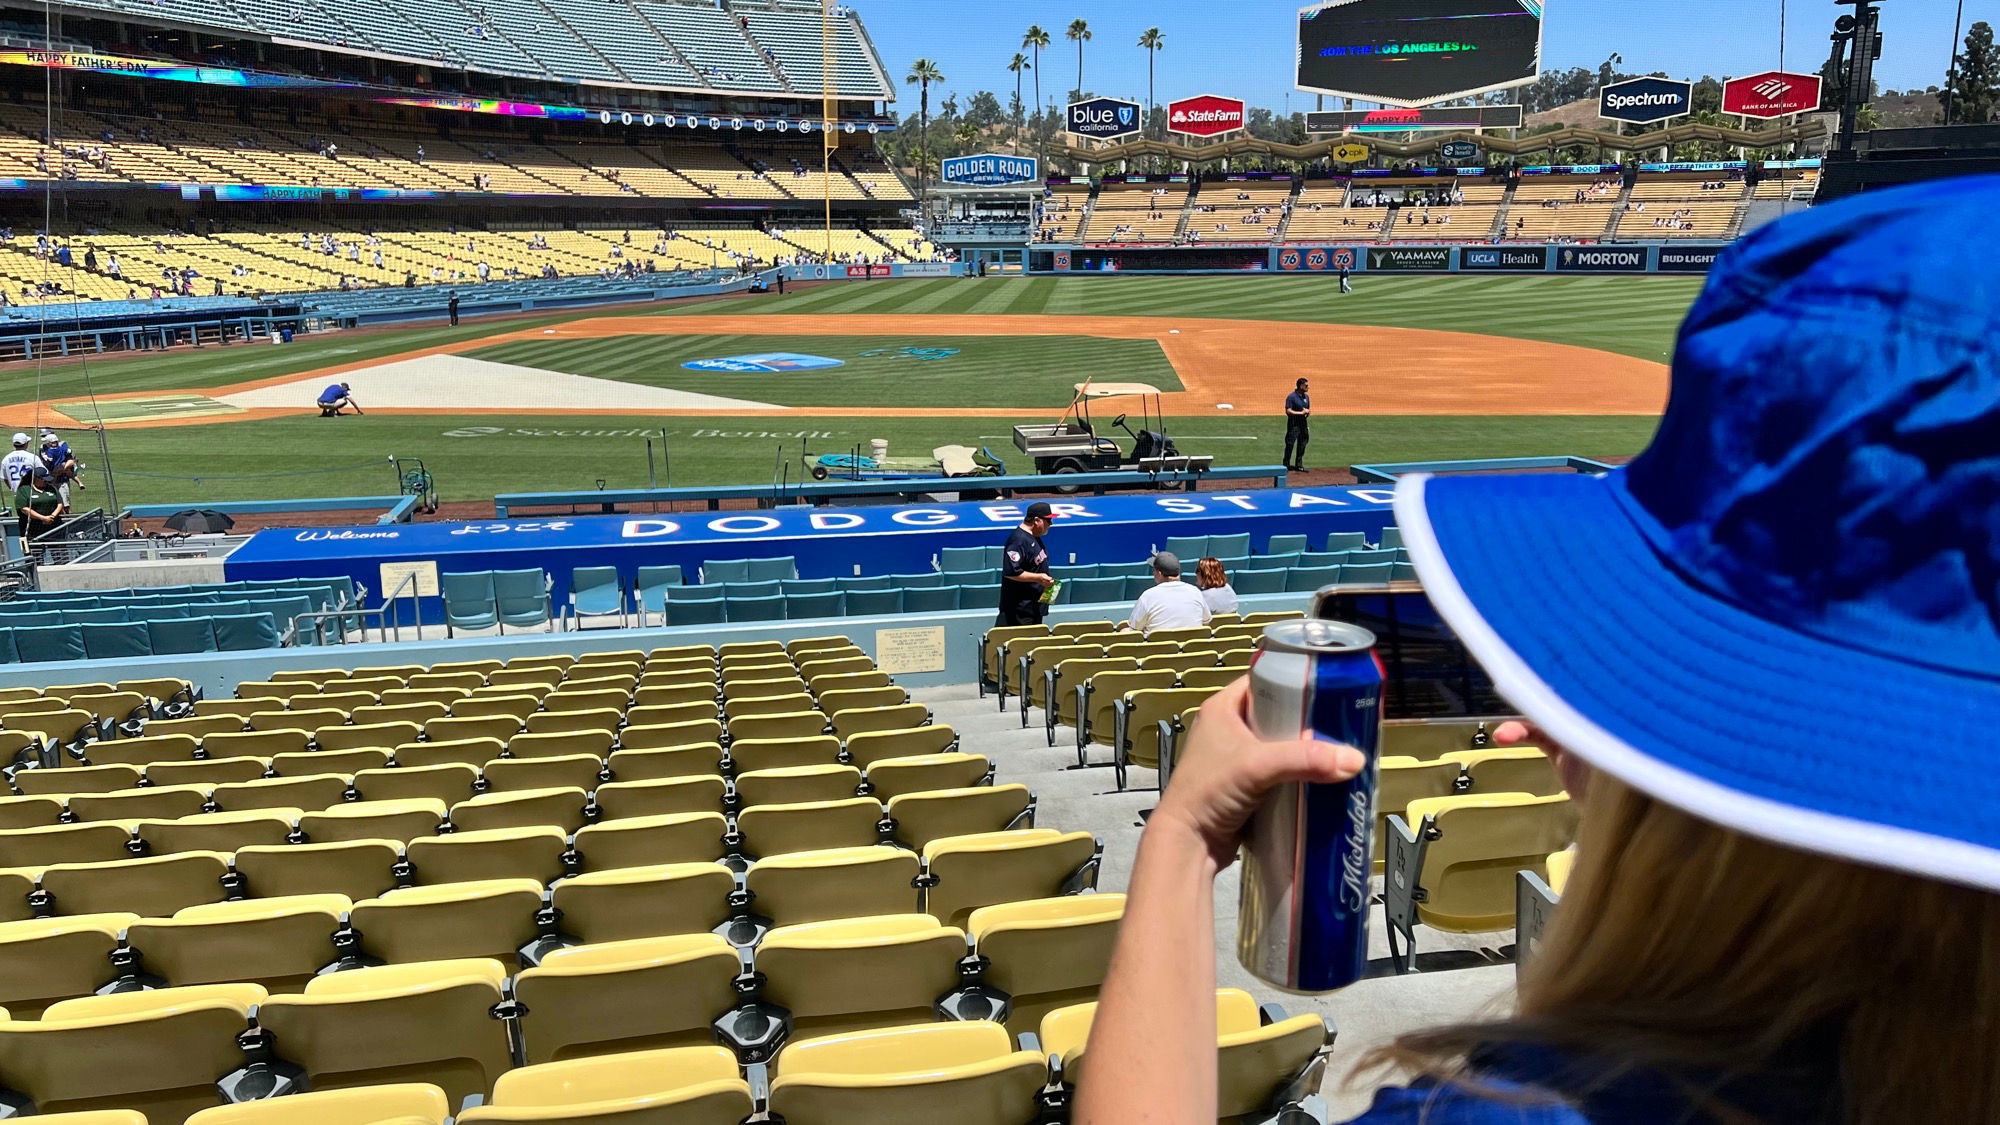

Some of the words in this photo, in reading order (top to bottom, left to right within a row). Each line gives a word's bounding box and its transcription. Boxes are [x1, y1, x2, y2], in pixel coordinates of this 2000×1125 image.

[1350, 45, 1372, 56] THE
[1375, 44, 1400, 54] LOS
[1401, 42, 1460, 54] ANGELES
[27, 52, 67, 66] HAPPY
[72, 56, 124, 72] FATHER'S
[126, 61, 148, 74] DAY
[1606, 93, 1678, 110] Spectrum
[1073, 106, 1114, 124] blue
[1367, 115, 1399, 124] HAPPY
[1079, 123, 1119, 132] california
[947, 159, 995, 179] GOLDEN
[999, 160, 1031, 178] ROAD
[1658, 163, 1686, 171] HAPPY
[1687, 162, 1721, 170] FATHER'S
[1723, 161, 1738, 169] DAY
[263, 188, 295, 200] HAPPY
[1057, 257, 1068, 265] 76
[1284, 254, 1297, 265] 76
[1310, 253, 1324, 265] 76
[1336, 253, 1350, 264] 76
[1471, 255, 1496, 263] UCLA
[1502, 253, 1539, 264] Health
[1577, 253, 1639, 265] MORTON
[1662, 255, 1684, 263] BUD
[1685, 255, 1716, 263] LIGHT
[508, 427, 681, 439] Security
[691, 428, 837, 439] Benefit
[622, 502, 1103, 538] DODGER
[450, 521, 574, 535] ようこそ
[295, 530, 400, 542] Welcome
[1340, 790, 1367, 913] Michelob
